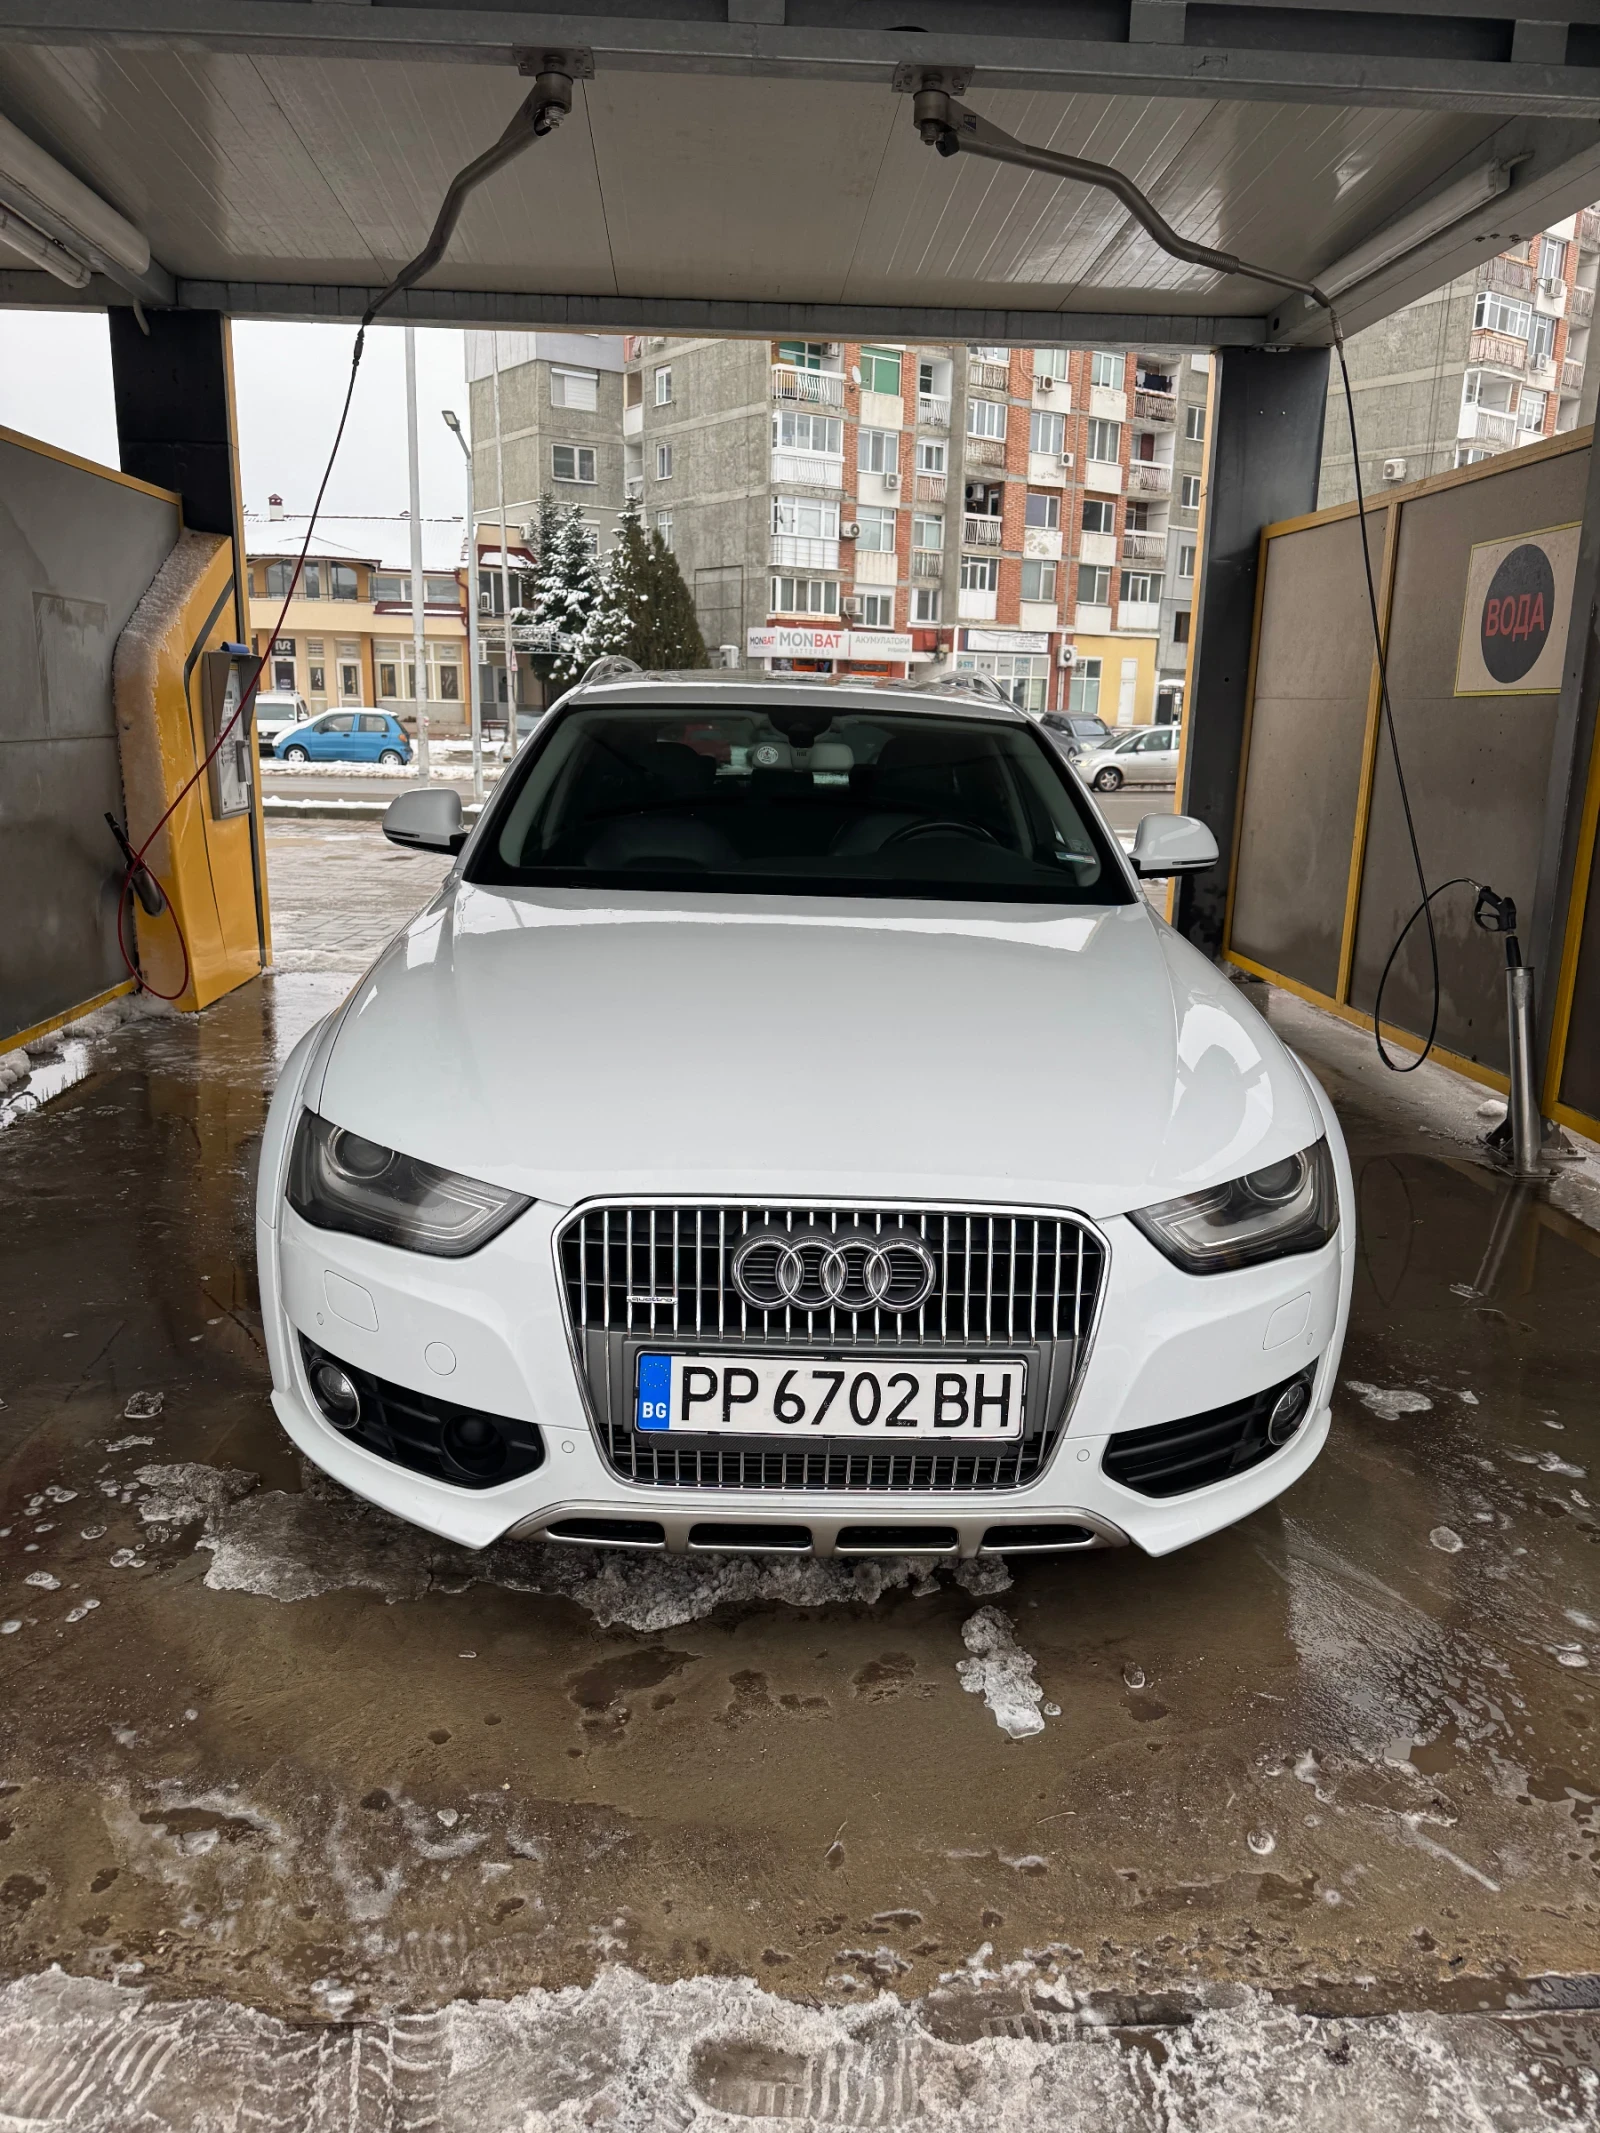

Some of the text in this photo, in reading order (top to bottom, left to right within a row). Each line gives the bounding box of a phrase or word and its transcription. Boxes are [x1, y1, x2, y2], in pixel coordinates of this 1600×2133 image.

[1485, 591, 1545, 642] ВОДА
[750, 636, 776, 645] MONBAT
[779, 632, 842, 648] MONBAT
[855, 635, 910, 645] АКУМУЛАТОРИ
[789, 648, 831, 656] BATTERIES
[681, 1366, 1012, 1428] PP 6702 BH
[642, 1401, 667, 1419] BG
